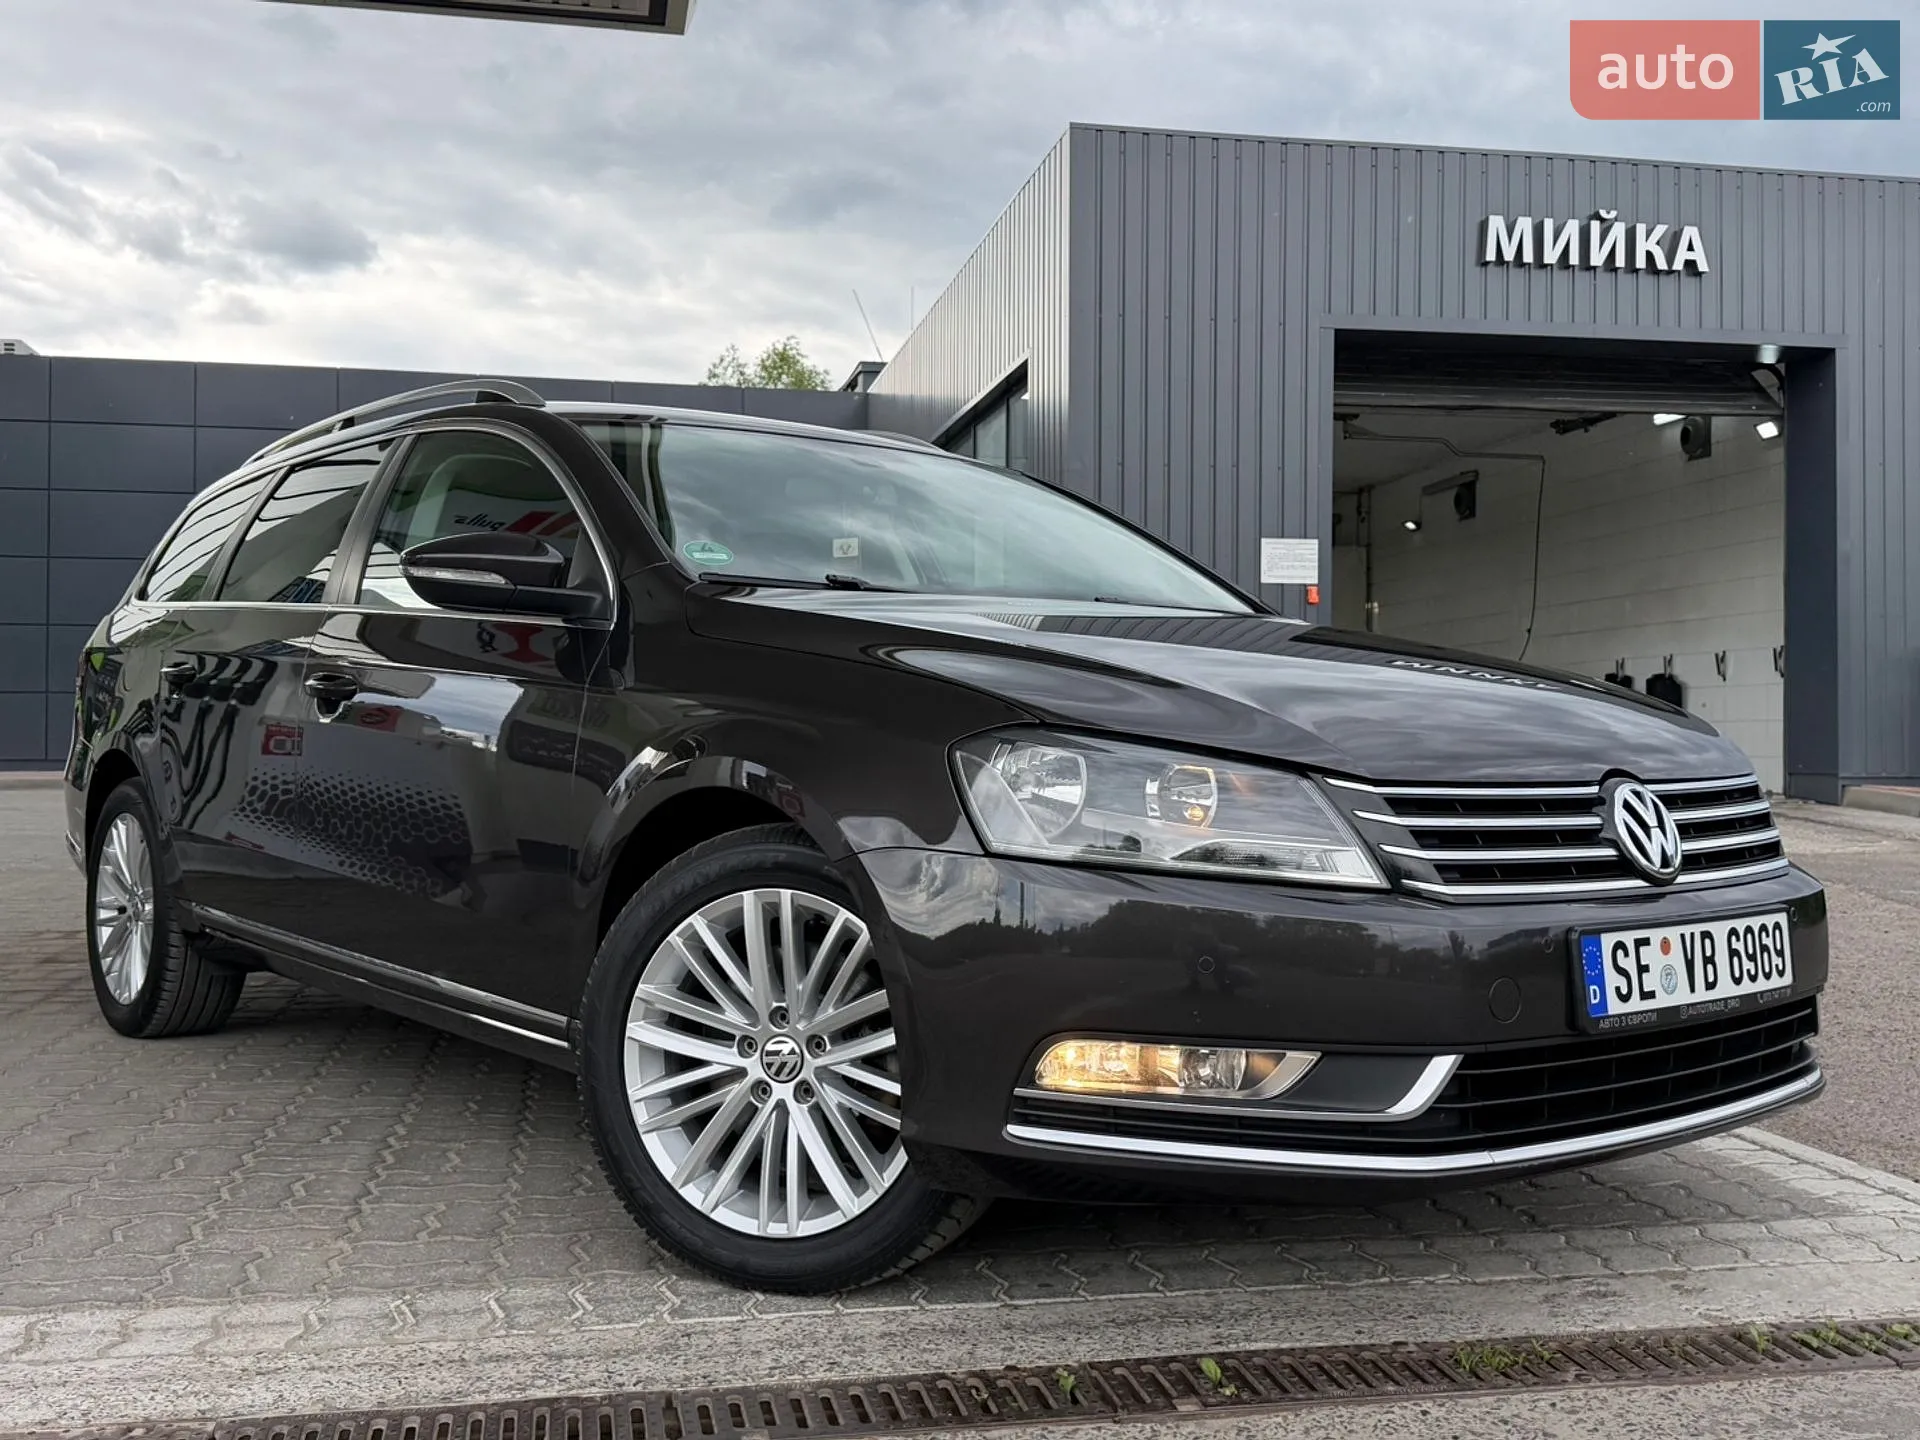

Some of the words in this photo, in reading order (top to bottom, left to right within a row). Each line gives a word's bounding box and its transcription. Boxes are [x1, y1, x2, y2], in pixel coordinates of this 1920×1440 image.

[1484, 208, 1710, 273] МИЙКА
[1589, 984, 1600, 1005] D
[1610, 935, 1657, 1004] SE
[1680, 929, 1719, 994] VB
[1726, 920, 1786, 986] 6969
